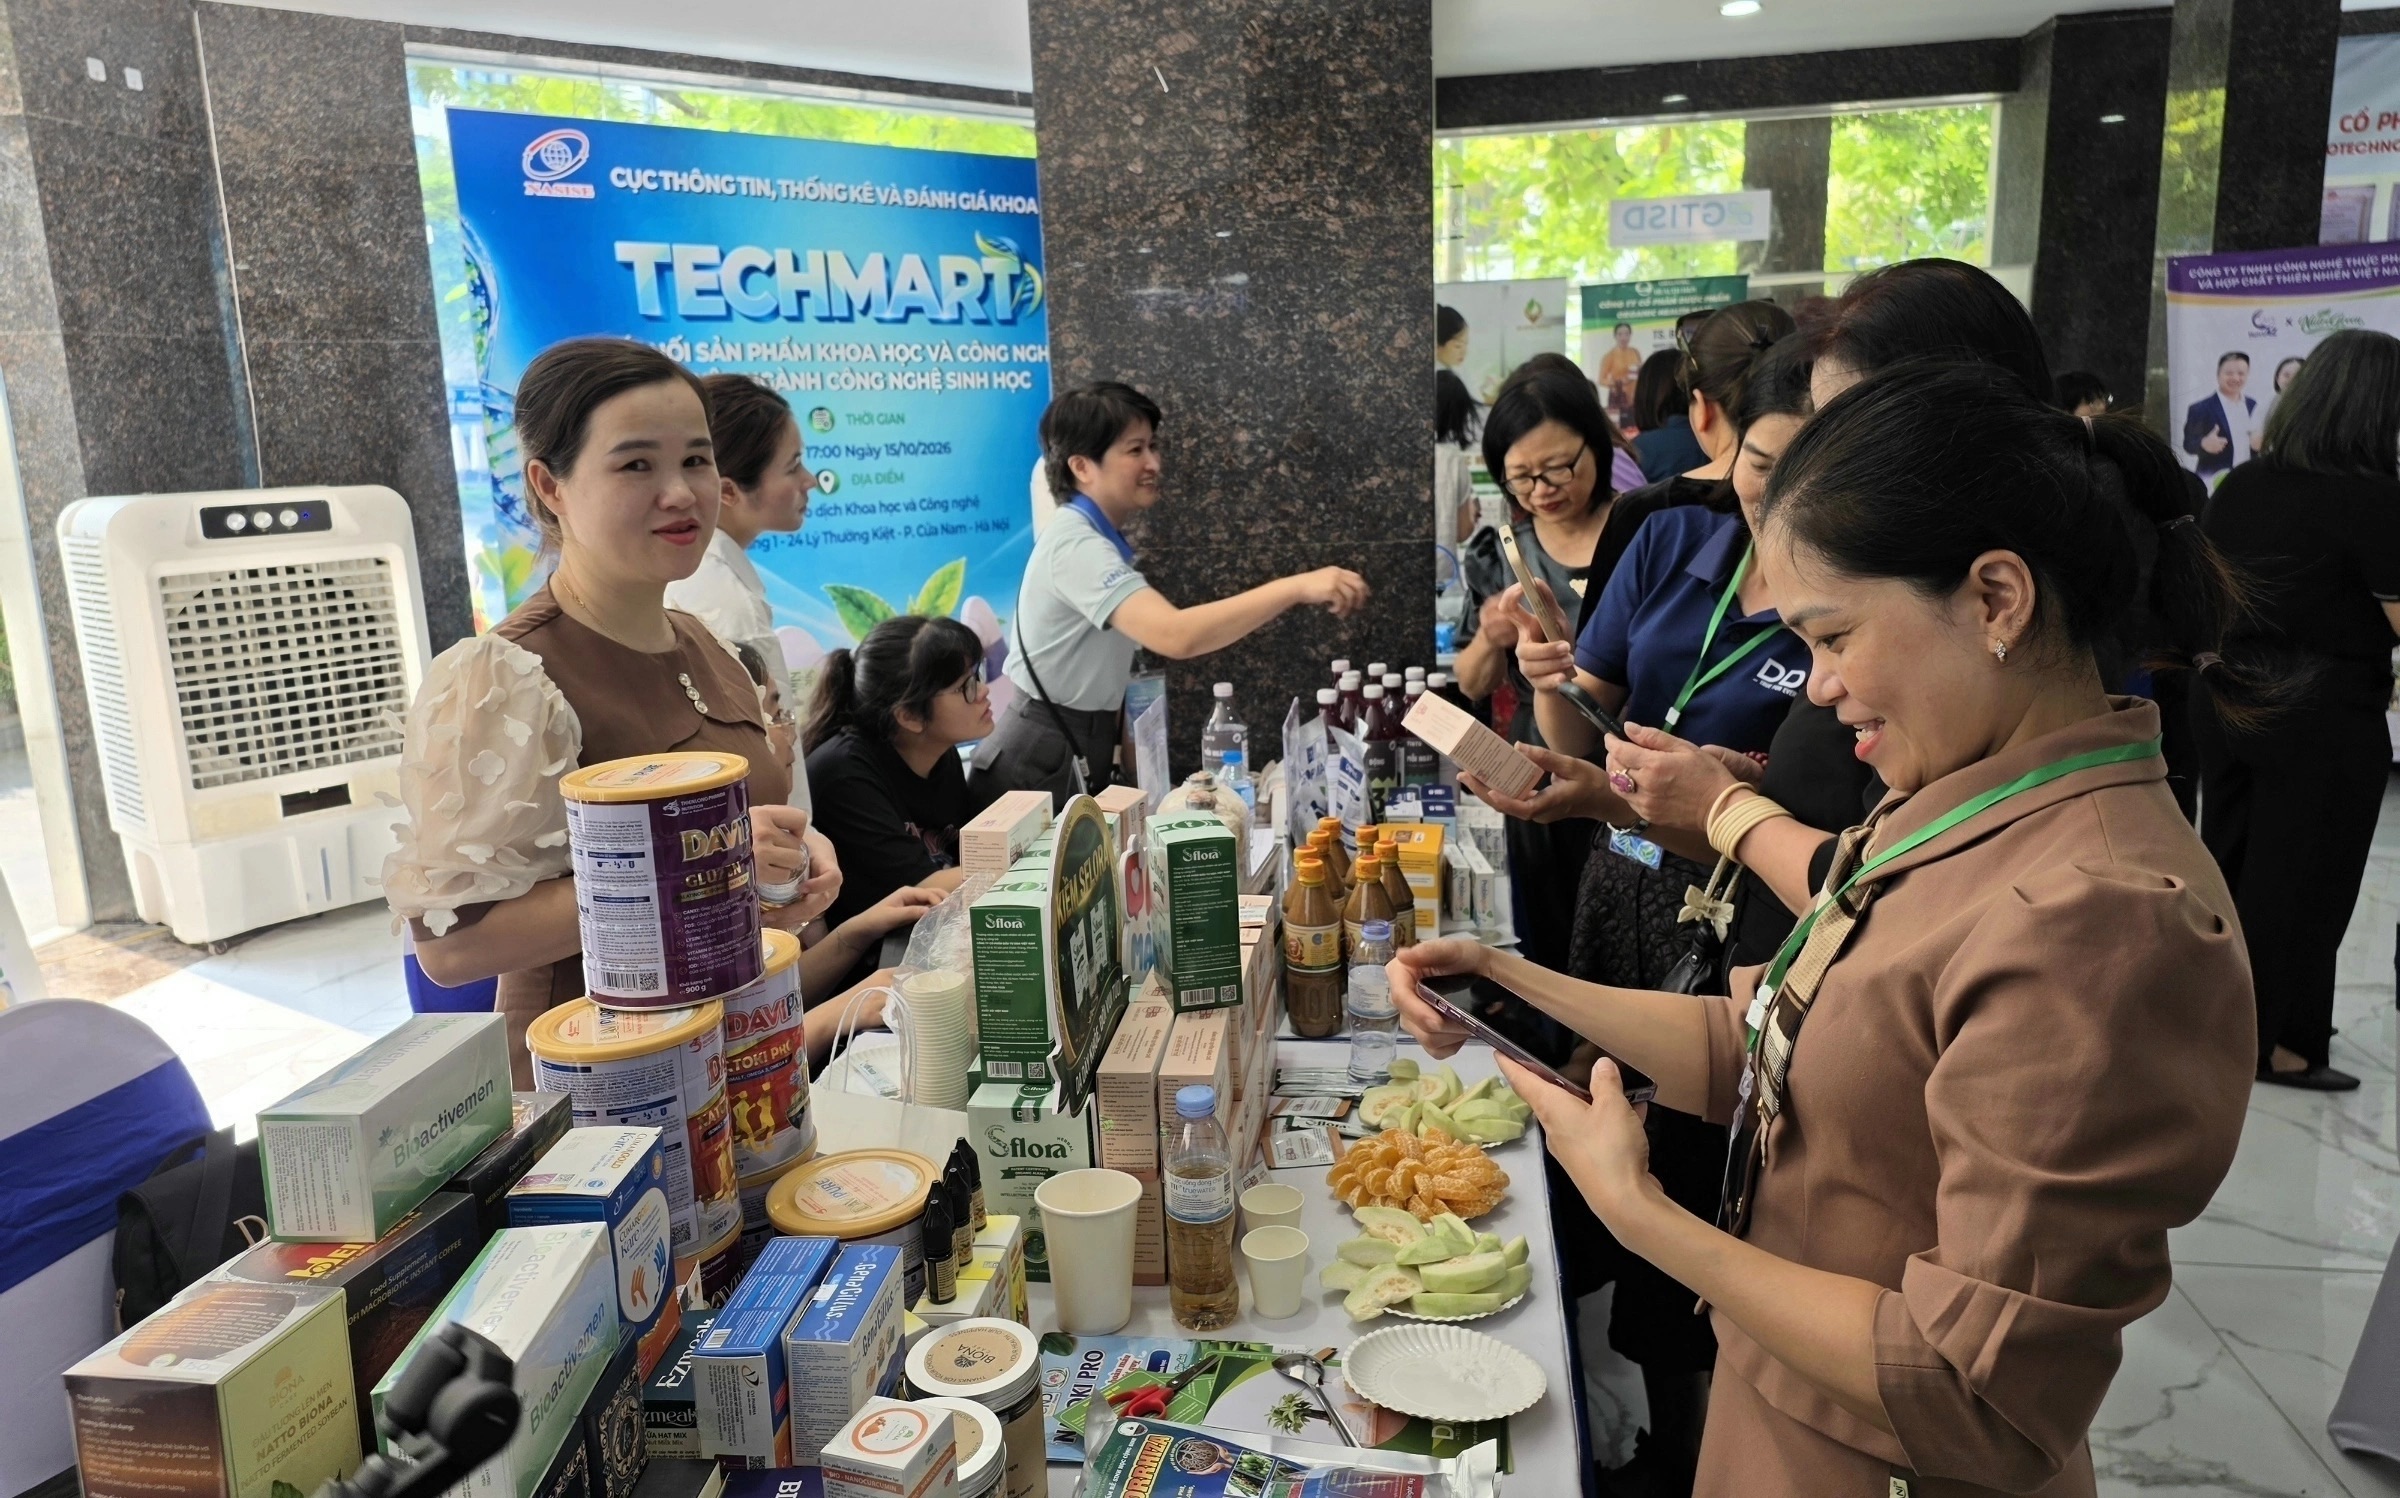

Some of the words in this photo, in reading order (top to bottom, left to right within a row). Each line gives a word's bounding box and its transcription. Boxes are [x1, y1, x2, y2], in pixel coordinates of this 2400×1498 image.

[2340, 106, 2370, 133] CỔ
[2377, 112, 2400, 132] PH
[610, 166, 657, 195] CỤC
[656, 167, 736, 195] THÔNG
[737, 175, 778, 201] TIN,
[777, 175, 848, 203] THỐNG
[849, 180, 876, 205] KÊ
[876, 183, 903, 207] VÀ
[903, 185, 958, 211] ĐÁNH
[959, 189, 989, 213] GIÁ
[989, 195, 1040, 215] KHOA
[613, 240, 1022, 324] TECHMART
[2382, 265, 2400, 277] NA
[695, 336, 745, 364] SẢN
[748, 335, 812, 363] PHẨM
[817, 343, 876, 363] KHOA
[879, 343, 923, 369] HỌC
[928, 337, 953, 363] VÀ
[955, 338, 1009, 364] CÔNG
[1012, 344, 1048, 363] NGH
[827, 366, 885, 392] CÔNG
[887, 366, 942, 396] NGHỆ
[945, 371, 991, 390] SINH
[993, 371, 1032, 395] HỌC
[876, 412, 906, 426] GIAN
[844, 444, 881, 461] Ngày
[844, 503, 877, 517] Khoa
[878, 501, 901, 517] học
[685, 985, 700, 994] 900
[391, 1077, 495, 1170] Bioactivemen
[986, 1126, 1068, 1159] Sflora
[369, 1280, 388, 1298] Food
[388, 1251, 428, 1287] Supplement
[528, 1301, 605, 1436] Bioactivemen
[1077, 1349, 1105, 1380] PRO
[256, 1425, 297, 1463] NATTO
[298, 1395, 334, 1430] BIONA
[271, 1425, 317, 1467] FERMENTED
[317, 1396, 348, 1431] SOYBEAN
[845, 1474, 897, 1492] NANOCURCUMIN
